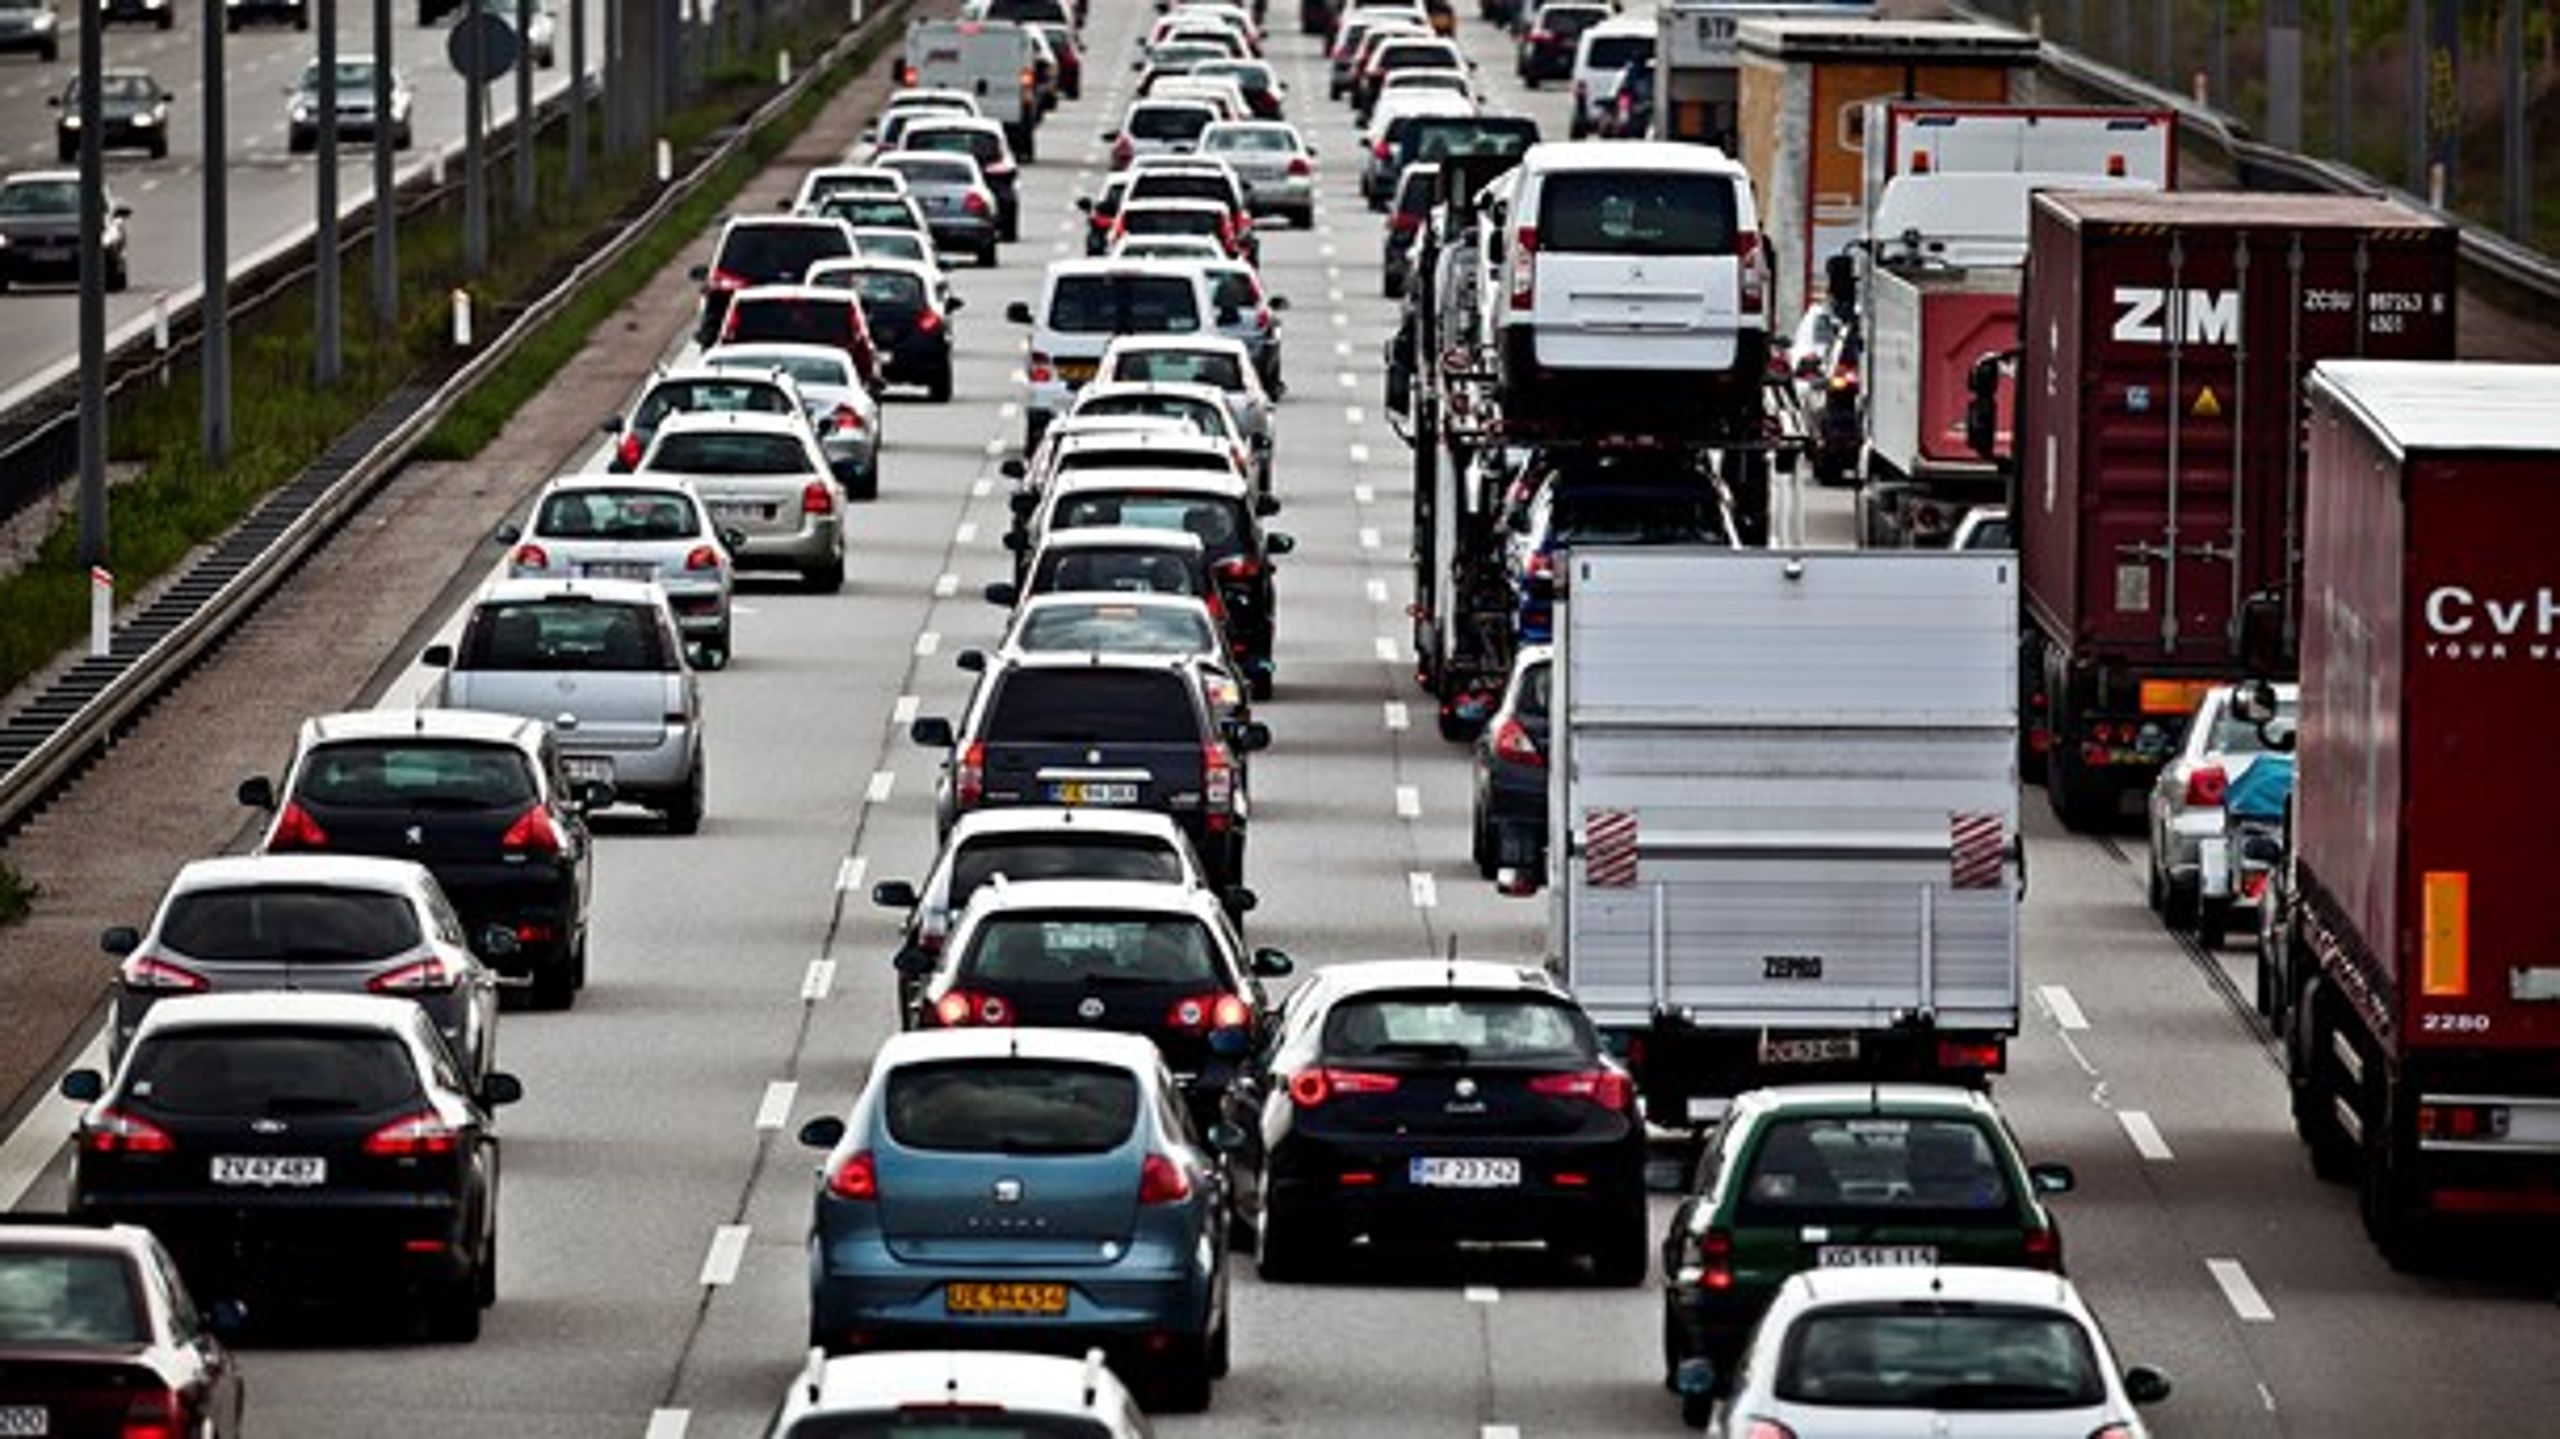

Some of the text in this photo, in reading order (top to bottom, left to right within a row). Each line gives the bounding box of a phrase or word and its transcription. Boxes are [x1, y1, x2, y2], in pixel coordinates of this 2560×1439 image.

[2113, 288, 2241, 343] ZIM
[2425, 642, 2507, 659] YOUR
[1762, 955, 1822, 979] ZEPRO
[2422, 1013, 2490, 1032] 2280
